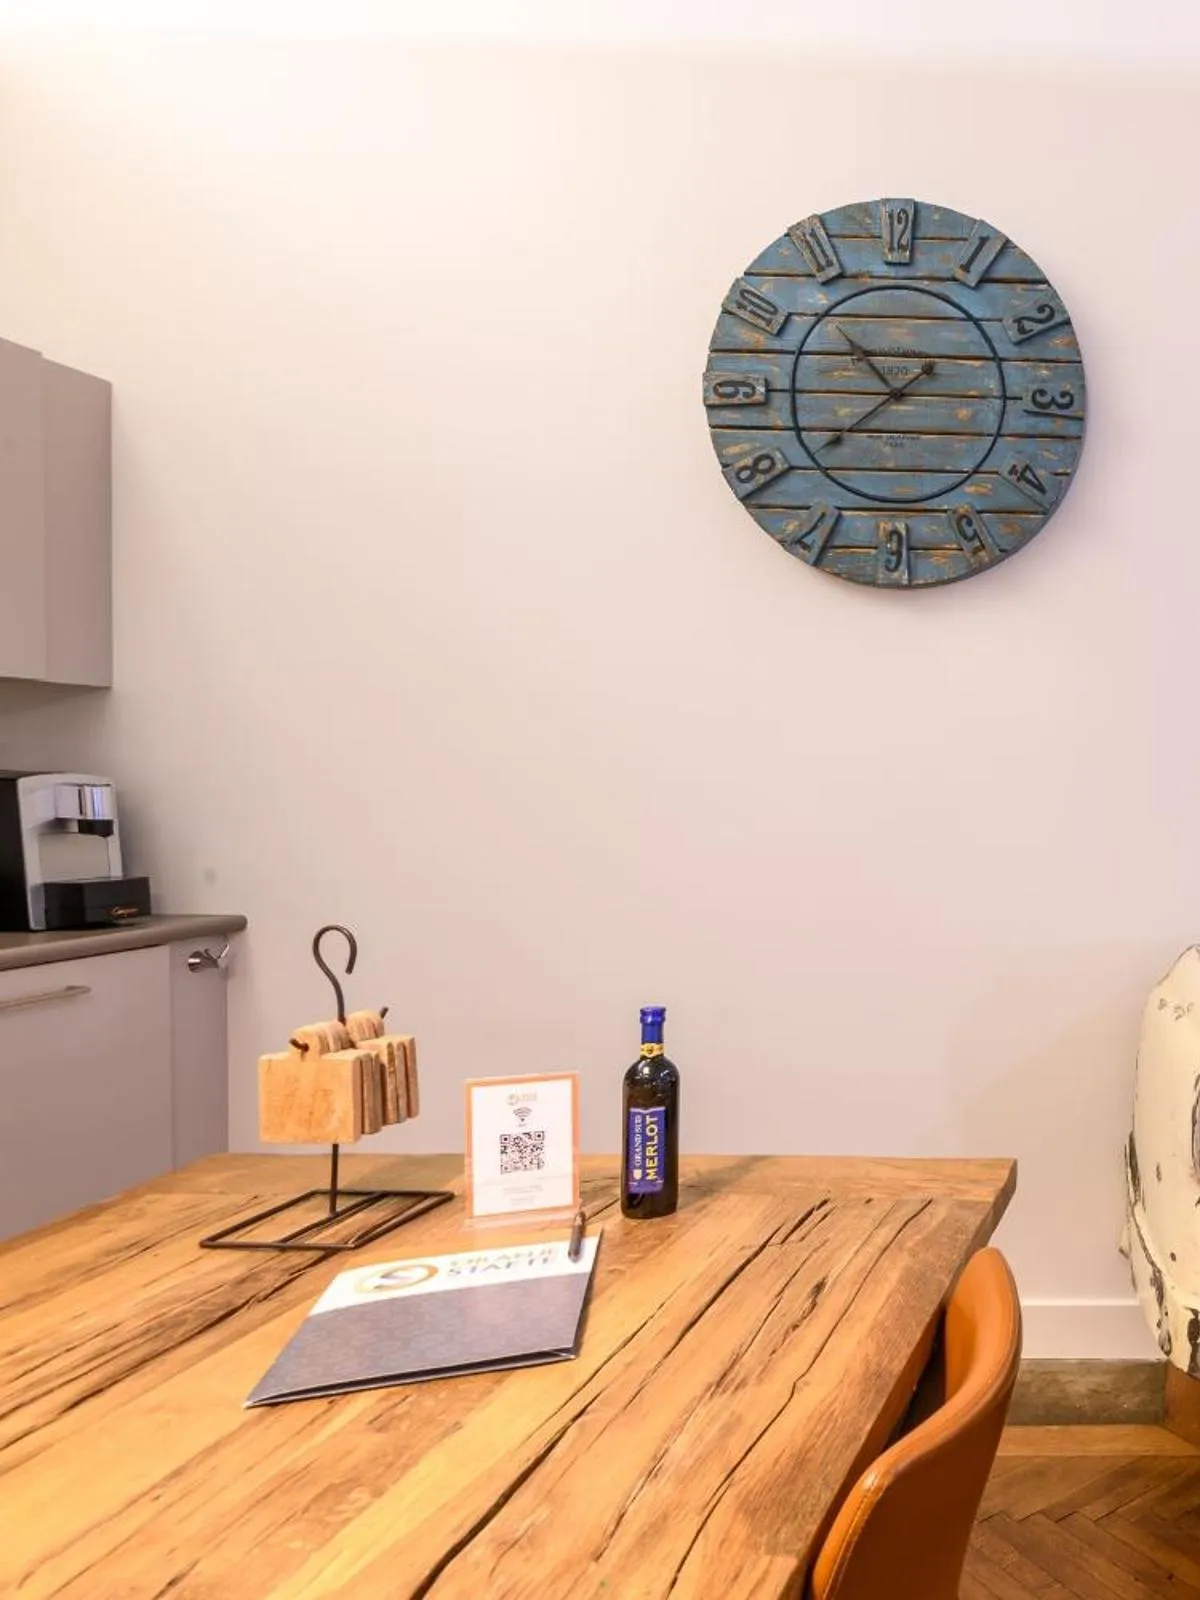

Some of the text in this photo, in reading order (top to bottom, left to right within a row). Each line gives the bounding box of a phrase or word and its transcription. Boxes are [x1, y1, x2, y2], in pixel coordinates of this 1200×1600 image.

[802, 228, 835, 273] 11
[886, 208, 910, 253] 12
[960, 235, 991, 275] 1
[736, 287, 779, 328] 10
[1012, 303, 1056, 336] 2
[1031, 387, 1075, 410] 3
[734, 453, 777, 484] 8
[1008, 463, 1048, 495] 4
[794, 510, 827, 553] 7
[955, 513, 988, 557] 5
[646, 1114, 658, 1180] MERLOT
